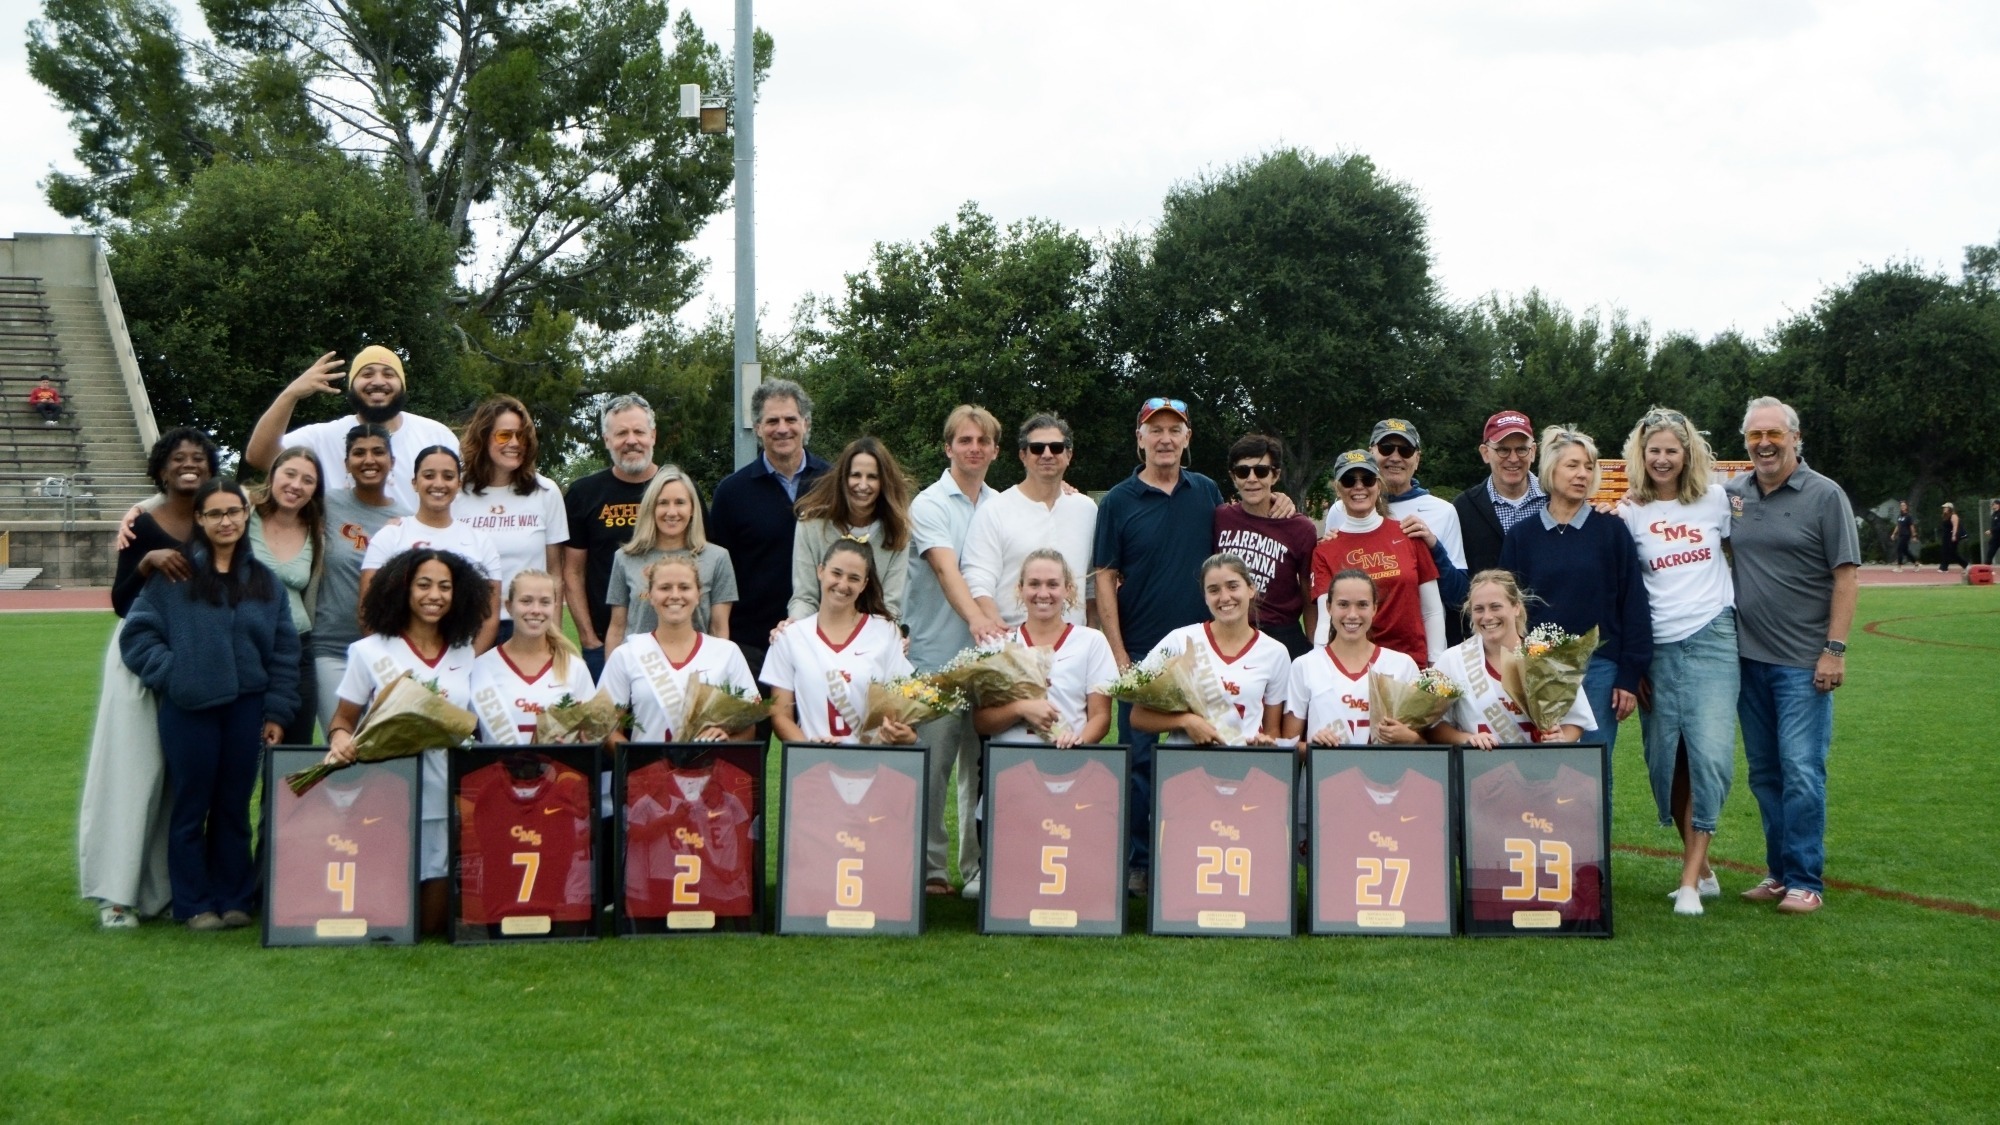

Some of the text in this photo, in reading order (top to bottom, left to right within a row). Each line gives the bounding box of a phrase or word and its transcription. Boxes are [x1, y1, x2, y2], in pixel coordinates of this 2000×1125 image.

[472, 515, 497, 528] LEAD
[499, 515, 516, 527] THE
[518, 514, 539, 528] WAY.
[1649, 520, 1703, 544] CMS
[1218, 529, 1288, 563] CLAREMONT
[1346, 548, 1399, 570] CMS
[1649, 547, 1712, 571] LACROSSE
[1221, 676, 1240, 695] MS
[1341, 694, 1369, 711] CMS
[1041, 818, 1071, 840] CMS
[1210, 819, 1240, 841] CMS
[1521, 811, 1554, 834] CMS
[327, 833, 359, 856] CMS
[510, 825, 542, 846] CMS
[675, 827, 705, 849] CMS
[836, 830, 866, 852] CMS
[1368, 830, 1399, 852] CMS
[512, 852, 540, 902] 7
[672, 854, 702, 904] 2
[1039, 845, 1068, 895] 5
[1196, 846, 1252, 896] 29
[1502, 838, 1572, 903] 33
[327, 862, 356, 912] 4
[836, 858, 863, 907] 6
[1356, 857, 1411, 907] 27
